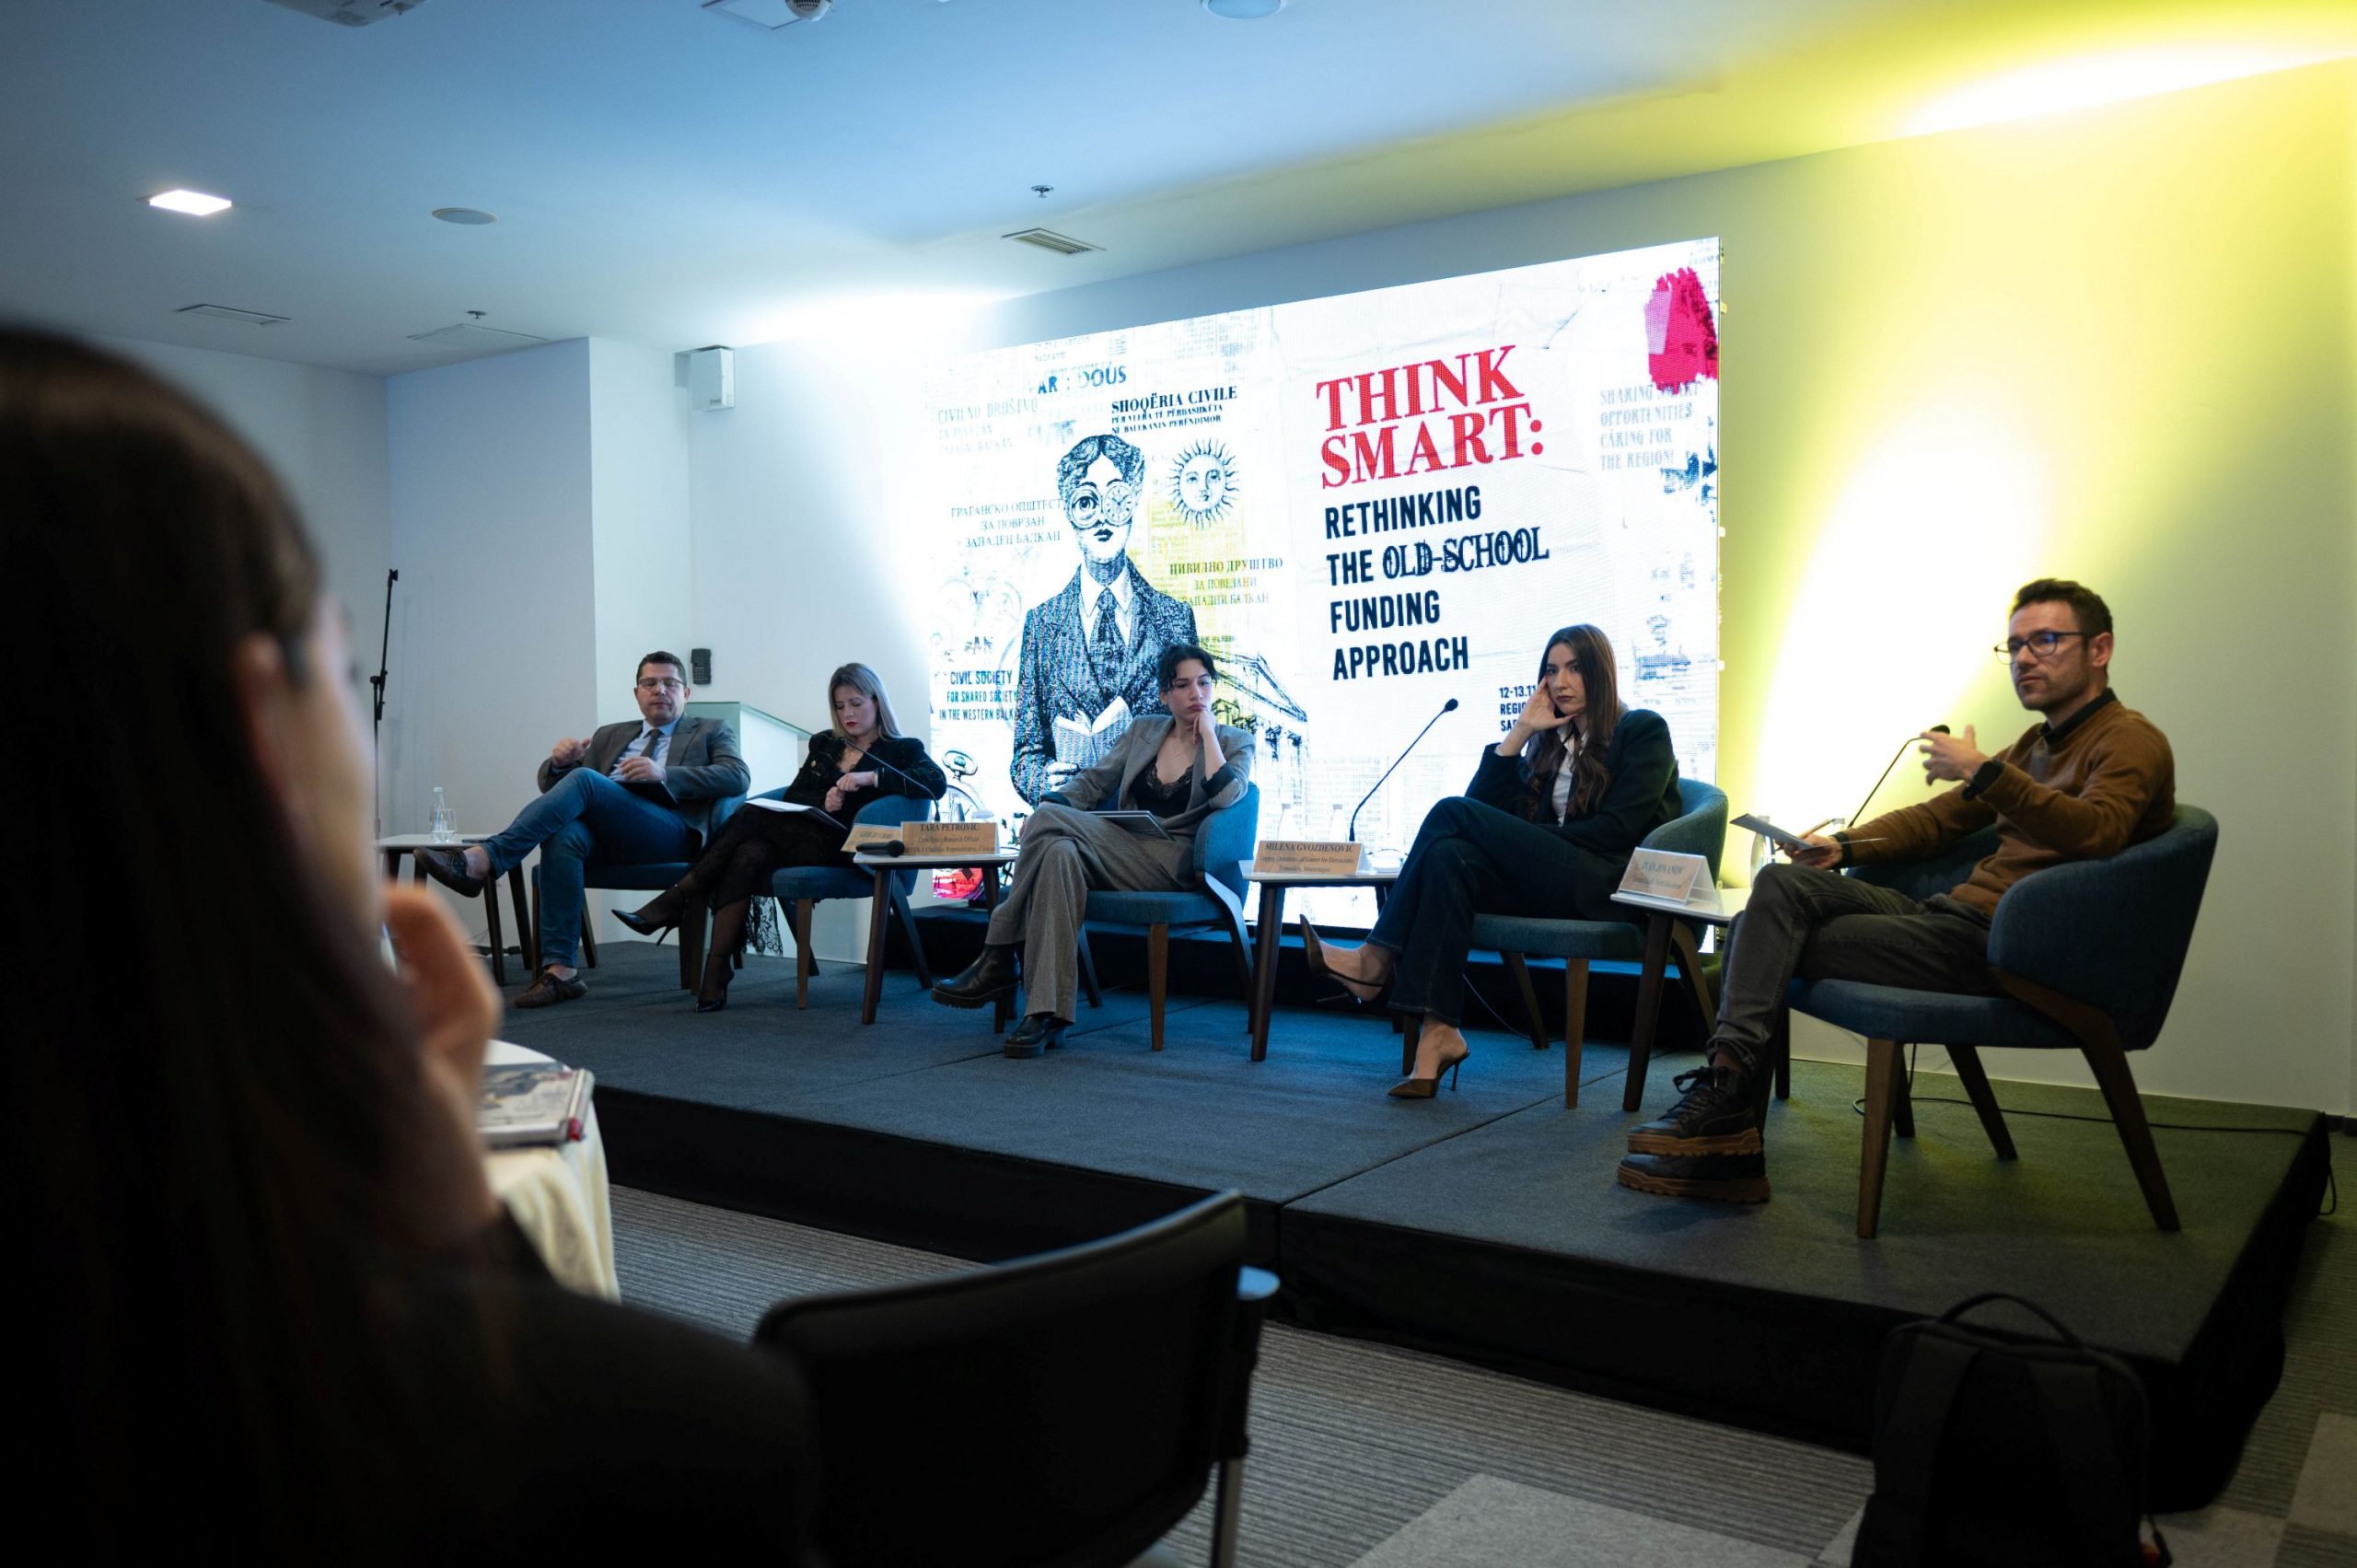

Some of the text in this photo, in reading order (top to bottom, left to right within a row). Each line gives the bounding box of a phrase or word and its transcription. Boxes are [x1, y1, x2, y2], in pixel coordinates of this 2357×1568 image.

[1111, 386, 1237, 415] SHOQËRIA CIVILE
[1317, 345, 1524, 431] THINK
[1600, 385, 1654, 406] SHARING
[1600, 401, 1693, 426] OPPORTUNITIES
[1321, 402, 1543, 489] SMART:
[1600, 427, 1672, 448] CARING FOR
[1600, 453, 1622, 470] THE
[1325, 485, 1481, 540] RETHINKING
[1327, 527, 1550, 587] THE OLD-SCHOOL
[1329, 590, 1441, 633] FUNDING
[1333, 636, 1469, 680] APPROACH
[950, 670, 1013, 685] CIVIL SOCIETY
[946, 691, 959, 703] FOR
[961, 691, 987, 703] SHARED
[939, 710, 946, 721] IN
[948, 710, 960, 721] THE
[962, 709, 993, 721] WESTERN
